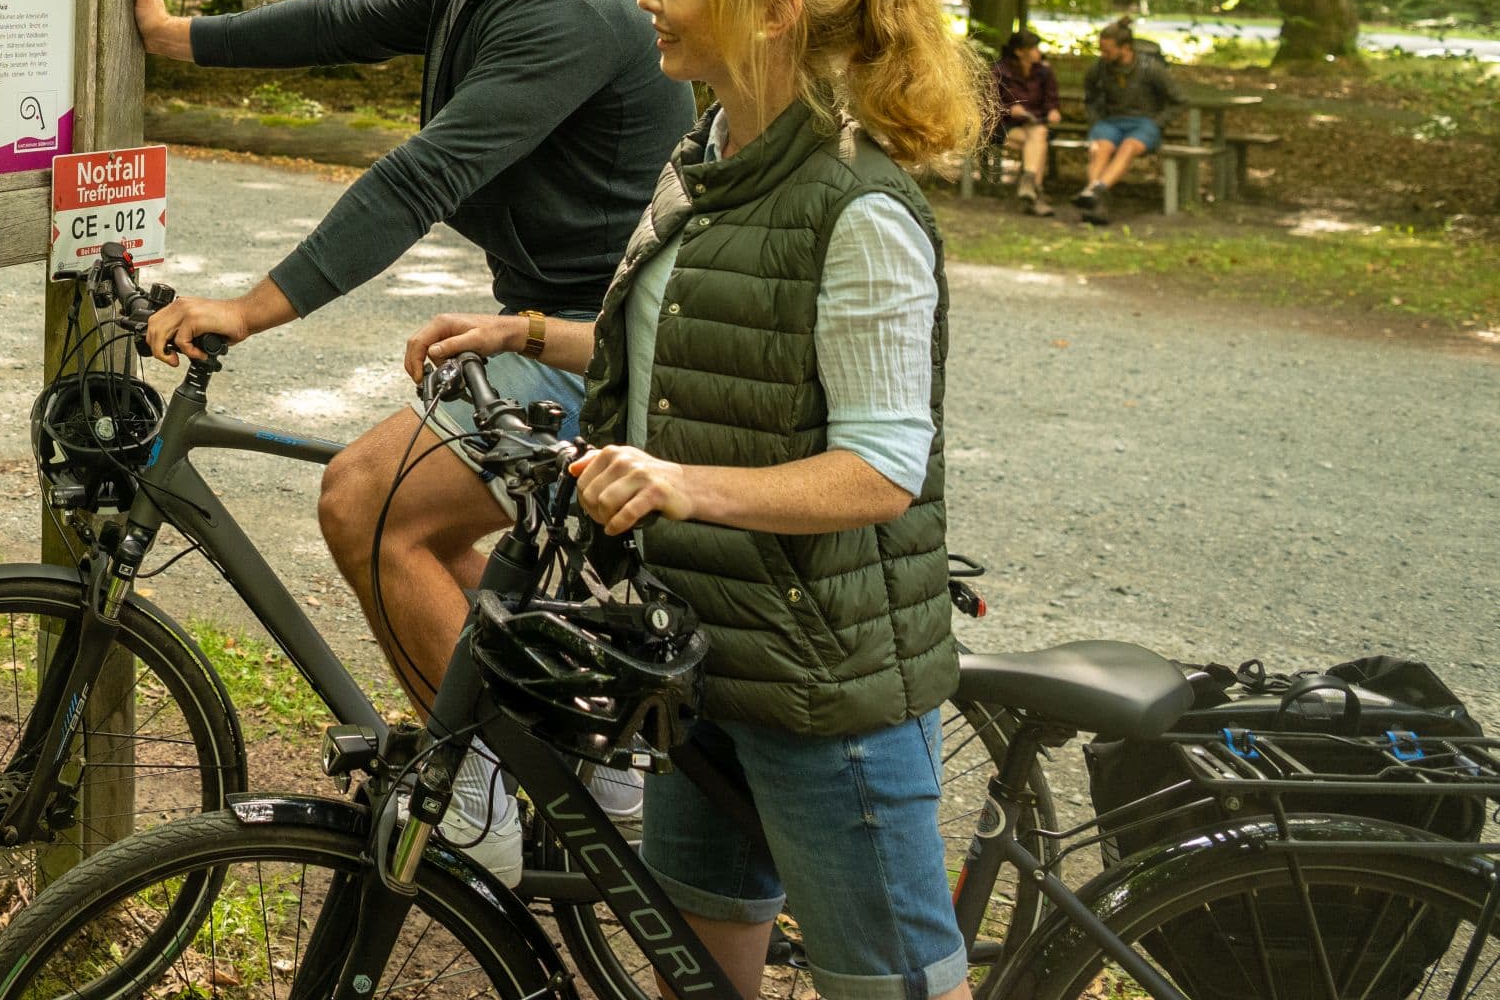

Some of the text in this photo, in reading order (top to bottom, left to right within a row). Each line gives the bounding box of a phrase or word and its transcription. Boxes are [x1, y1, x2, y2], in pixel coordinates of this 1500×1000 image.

[77, 154, 144, 185] Notfall
[77, 181, 145, 203] Treffpunkt
[72, 215, 98, 239] CE
[116, 208, 145, 232] 012
[547, 792, 714, 992] VICTORI
